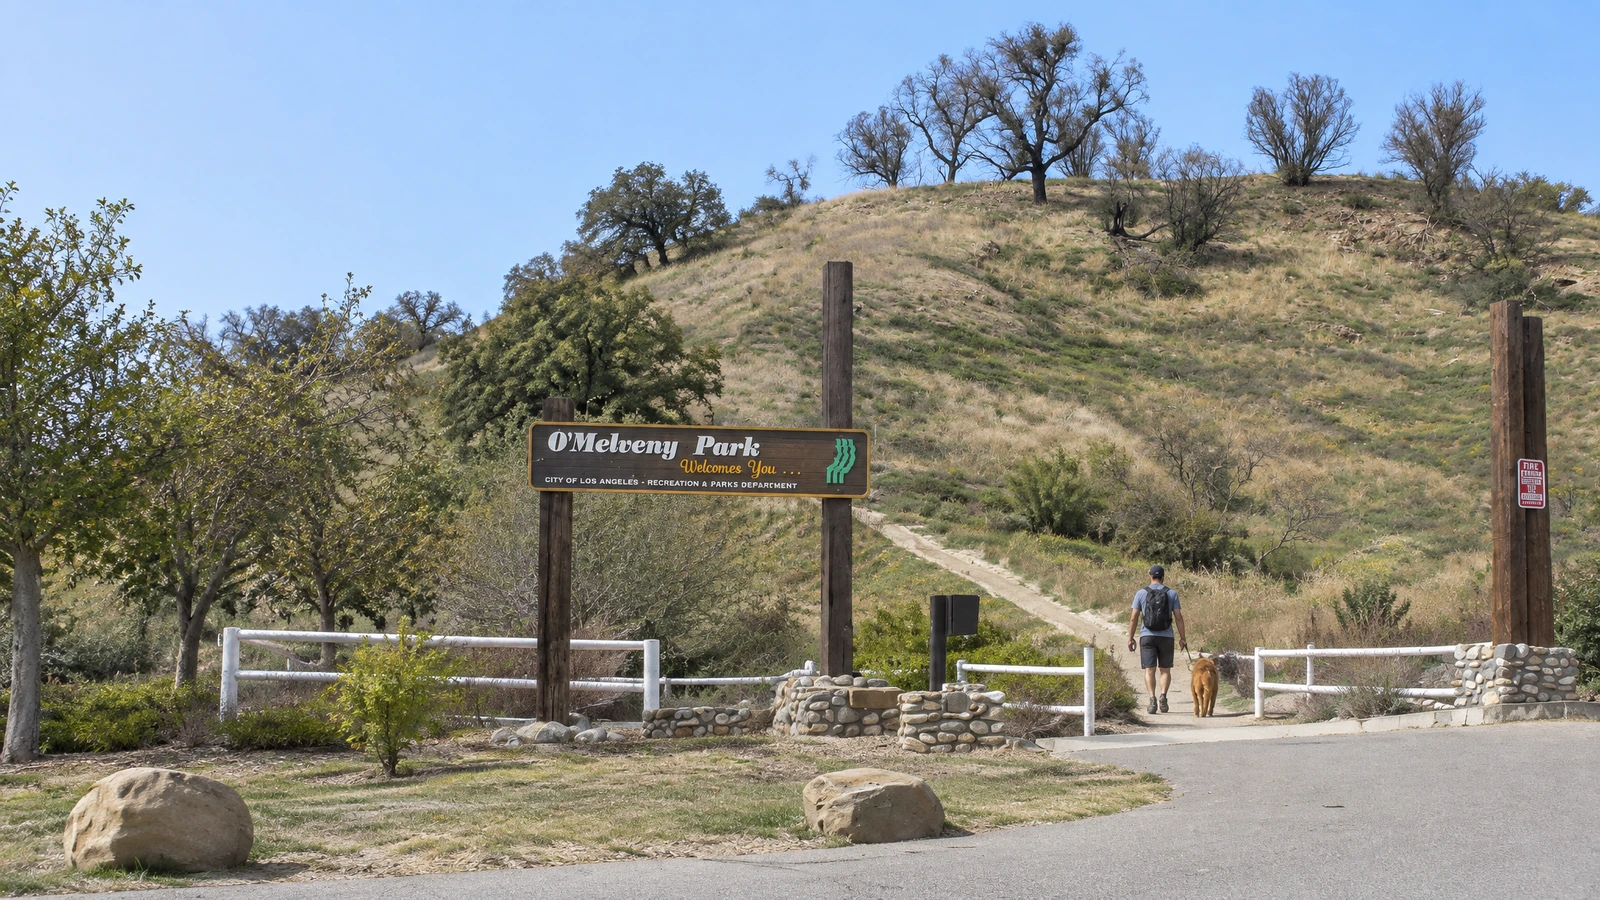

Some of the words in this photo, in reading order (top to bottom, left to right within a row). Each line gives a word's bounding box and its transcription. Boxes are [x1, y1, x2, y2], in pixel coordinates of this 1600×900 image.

[548, 431, 678, 460] O'Melveny
[692, 435, 760, 457] Park
[680, 458, 742, 474] Welcomes
[747, 459, 777, 479] You
[647, 479, 699, 487] RECREATION
